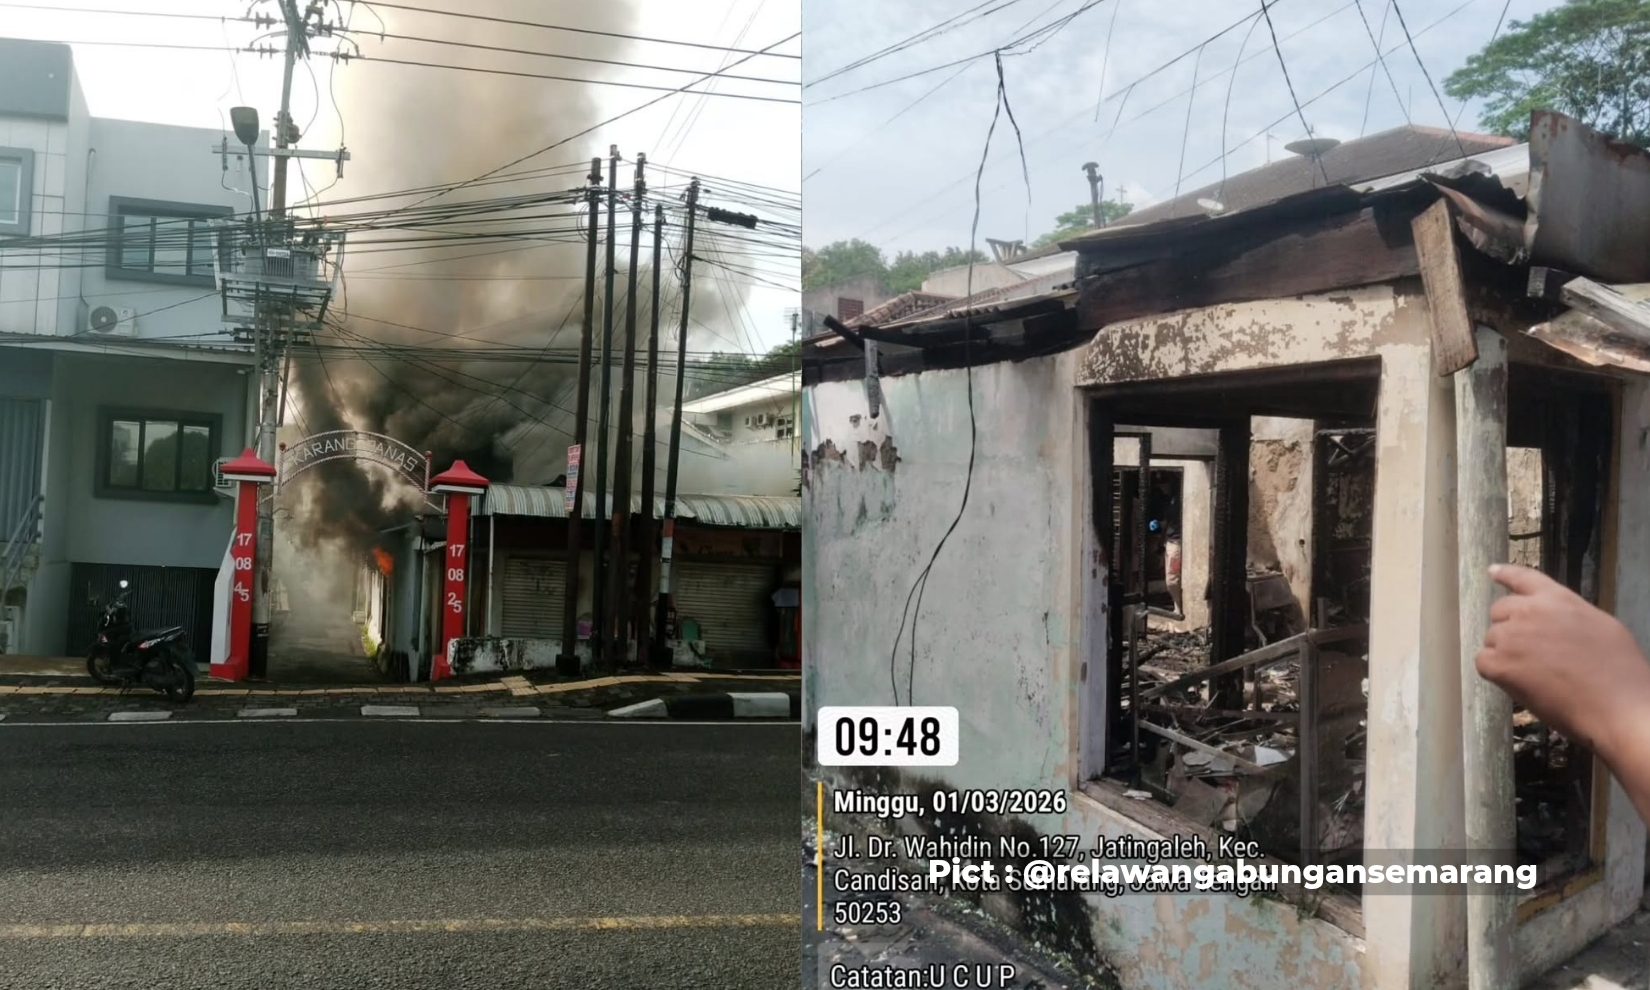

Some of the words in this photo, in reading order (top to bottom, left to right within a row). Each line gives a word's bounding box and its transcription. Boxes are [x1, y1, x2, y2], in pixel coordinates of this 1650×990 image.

[292, 437, 356, 466] KARANG
[367, 439, 418, 472] PANAS
[236, 533, 252, 546] 17
[449, 544, 465, 557] 17
[235, 556, 252, 571] 08
[447, 568, 464, 582] 08
[233, 582, 250, 602] 45
[447, 593, 462, 613] 25
